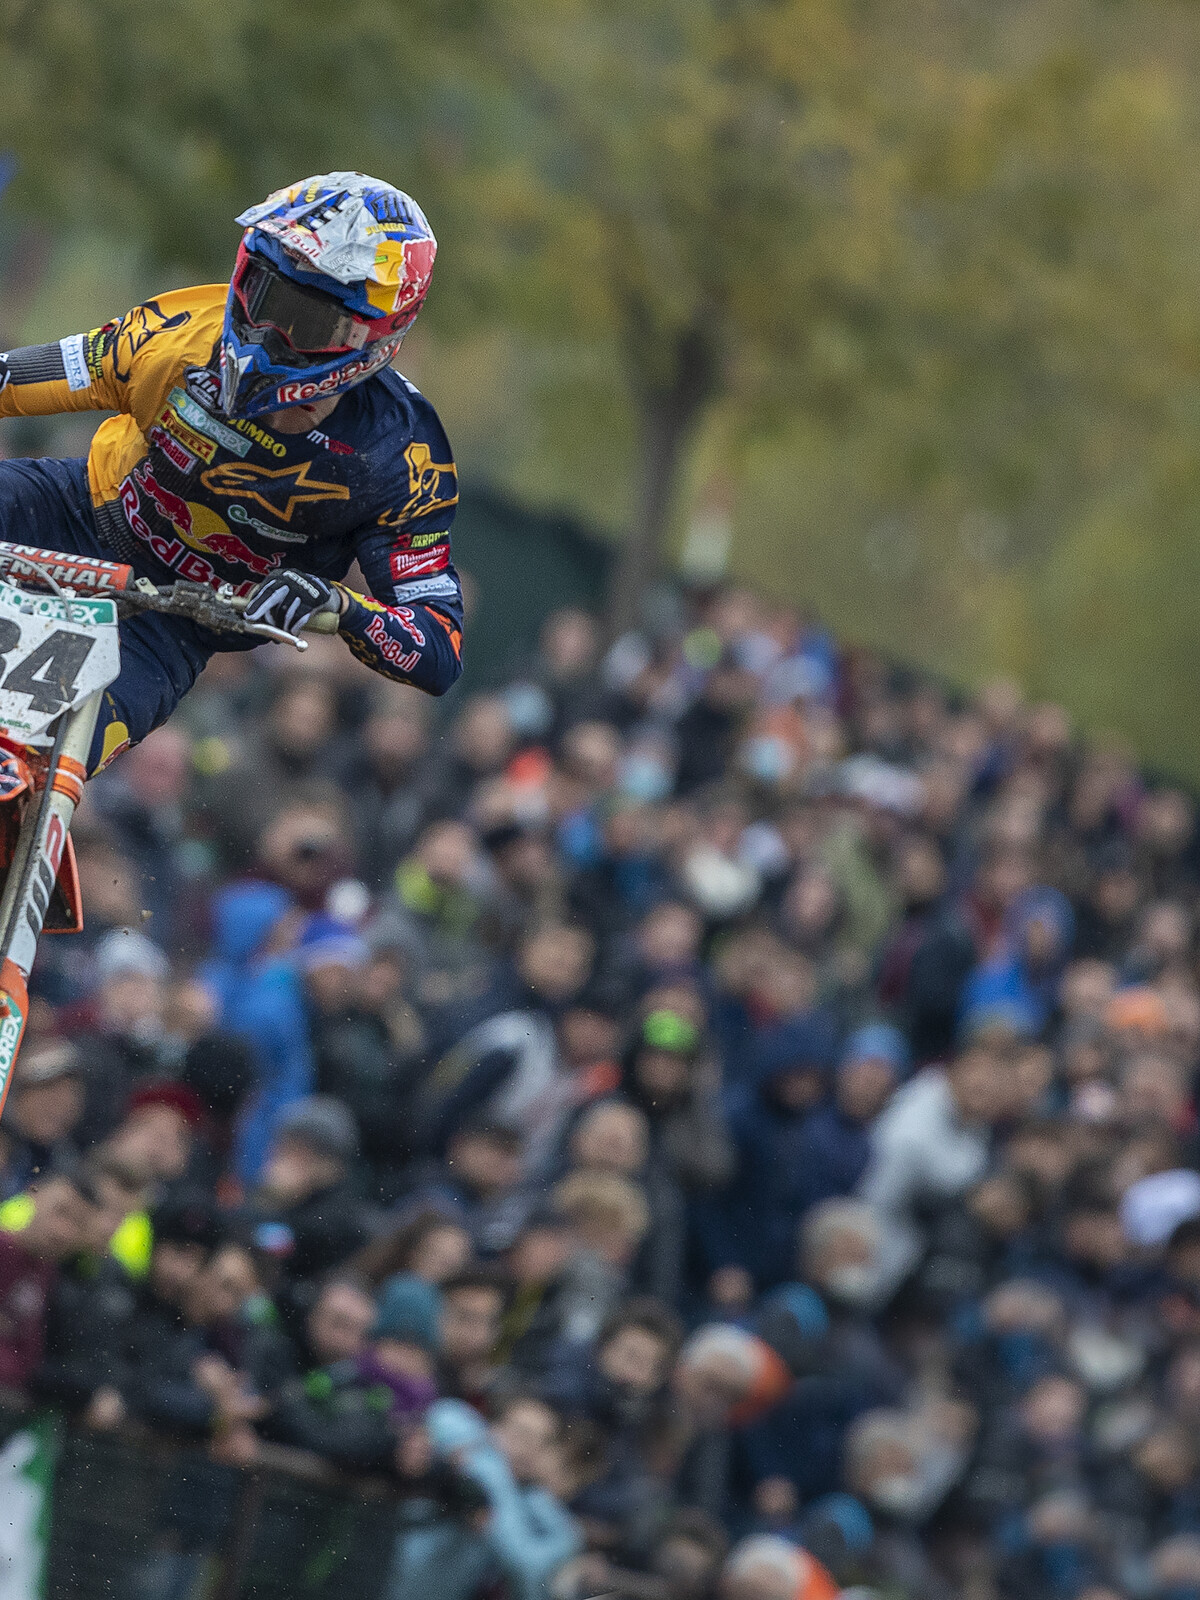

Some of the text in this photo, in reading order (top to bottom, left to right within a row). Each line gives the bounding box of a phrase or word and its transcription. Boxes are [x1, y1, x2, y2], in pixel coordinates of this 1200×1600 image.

[290, 232, 321, 259] Bull
[277, 341, 395, 404] Red Bull
[184, 403, 245, 455] MOTOREX
[227, 418, 287, 457] UMBO
[118, 476, 257, 598] Red Bul
[394, 547, 447, 571] Milwaukee
[384, 639, 422, 672] Bull
